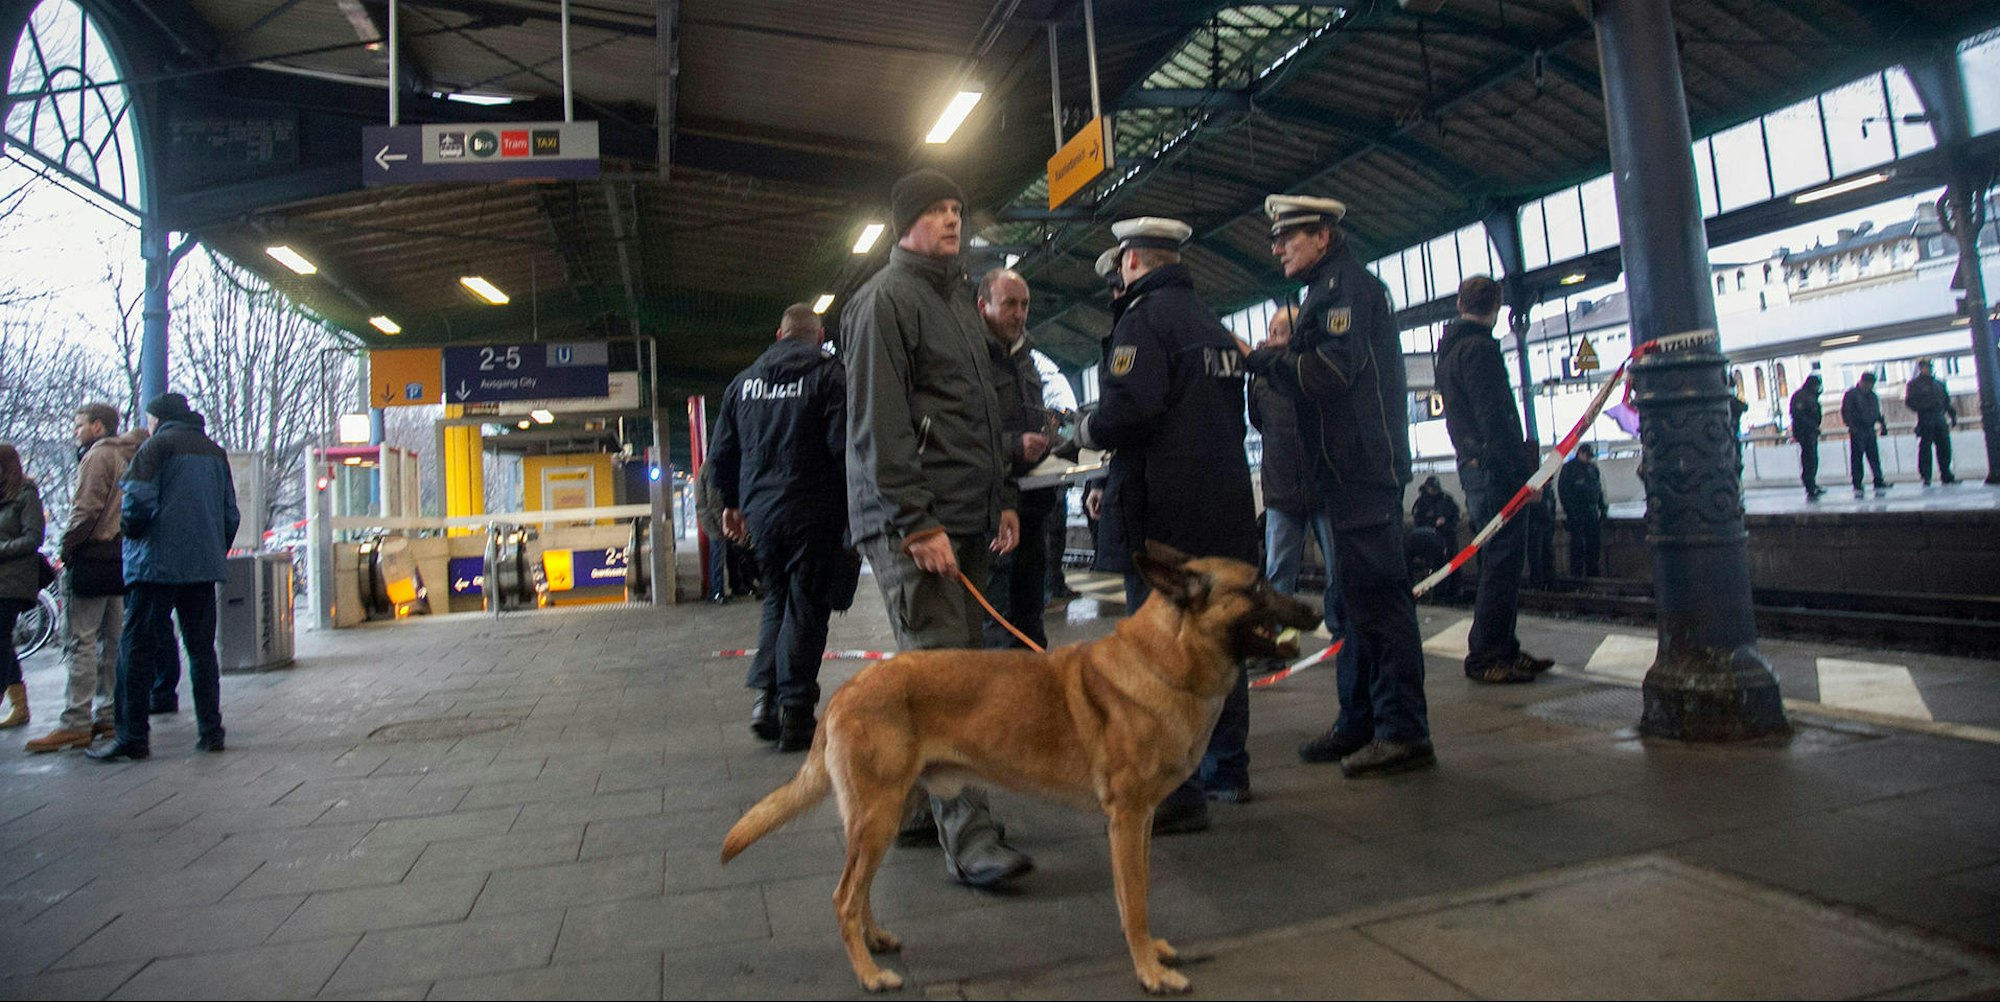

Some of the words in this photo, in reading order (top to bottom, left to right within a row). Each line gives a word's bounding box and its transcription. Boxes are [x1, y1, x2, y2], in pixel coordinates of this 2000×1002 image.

[474, 137, 494, 151] Bus
[503, 137, 528, 150] Tram
[536, 137, 557, 148] TAXI
[479, 345, 521, 371] 2-5
[558, 347, 572, 364] U
[480, 378, 518, 390] Ausgang
[519, 377, 537, 389] City
[742, 376, 804, 401] POLIZEI
